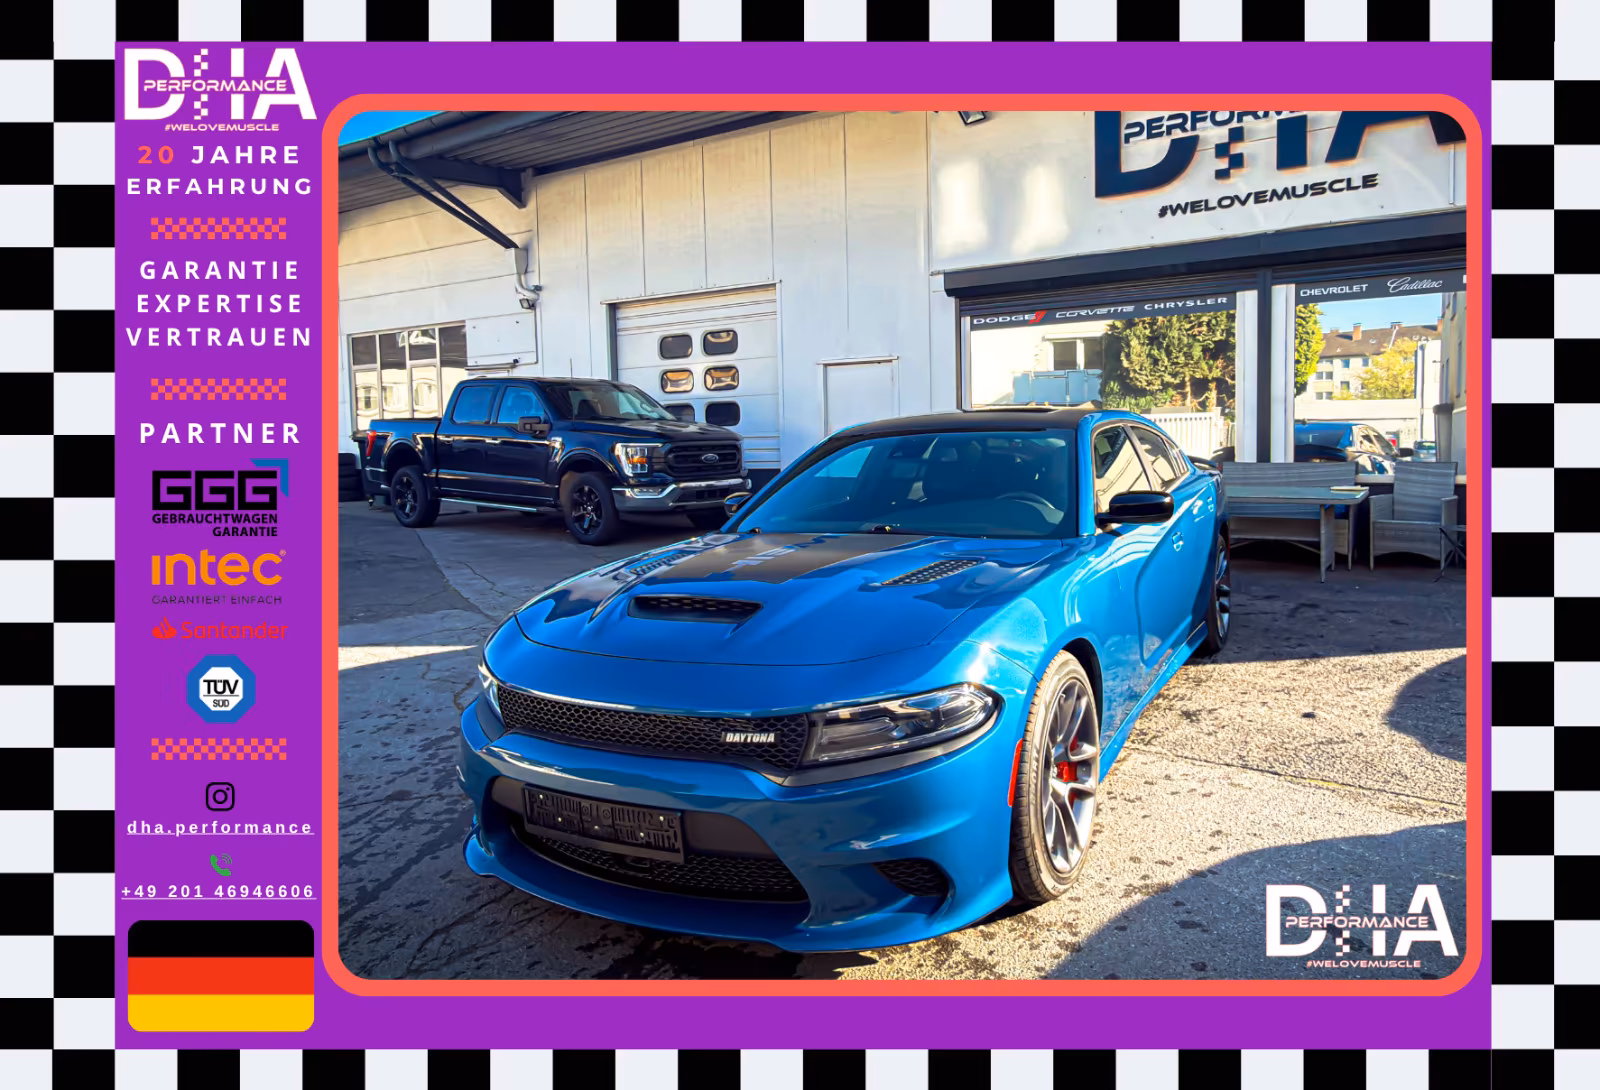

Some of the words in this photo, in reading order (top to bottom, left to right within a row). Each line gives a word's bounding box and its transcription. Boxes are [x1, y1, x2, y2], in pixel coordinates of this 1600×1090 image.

[1158, 173, 1379, 218] #WELOVEMUSCLE
[1300, 284, 1369, 297] CHEVROLET
[1387, 276, 1443, 293] Cadillac
[973, 313, 1037, 325] DODGE
[1055, 305, 1136, 319] CORVETTE
[1144, 297, 1228, 311] CHRYSLER
[725, 732, 775, 743] DAYTONA
